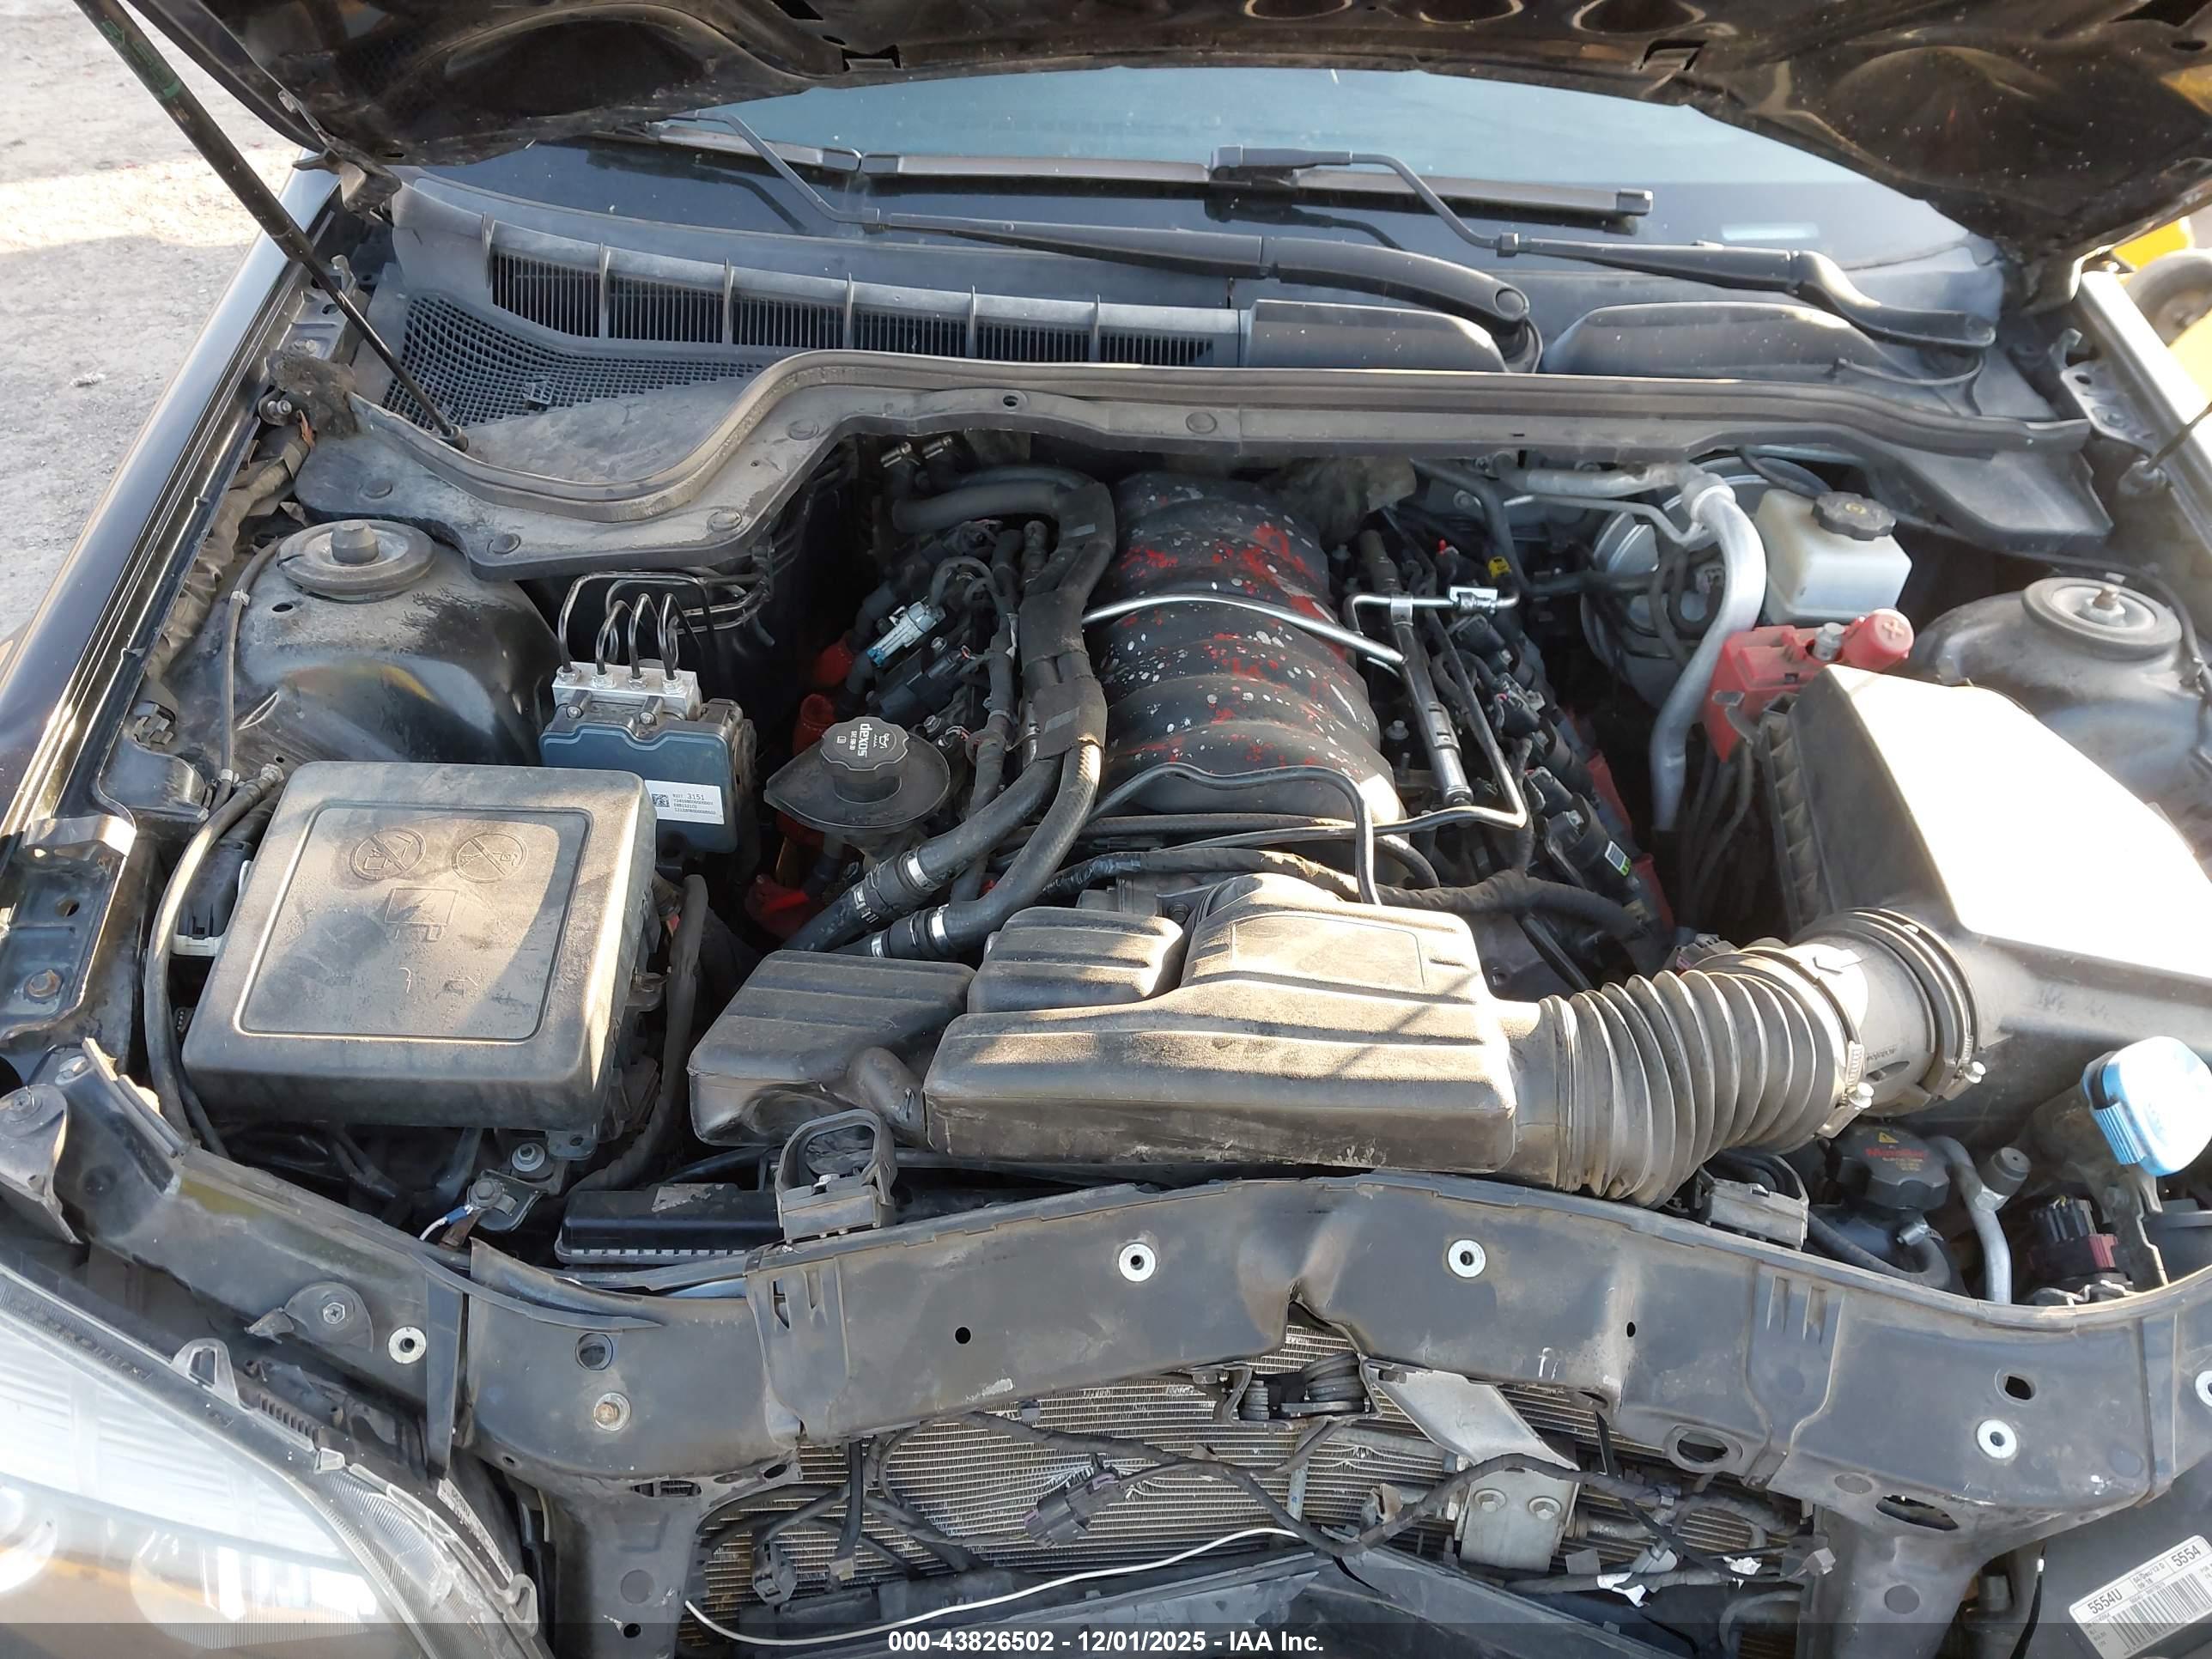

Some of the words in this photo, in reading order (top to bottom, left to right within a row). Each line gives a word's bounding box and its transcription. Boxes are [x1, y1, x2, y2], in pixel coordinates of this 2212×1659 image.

[857, 723, 873, 758] dexos
[2171, 1545, 2202, 1567] 5554
[2087, 1588, 2123, 1614] 5554U
